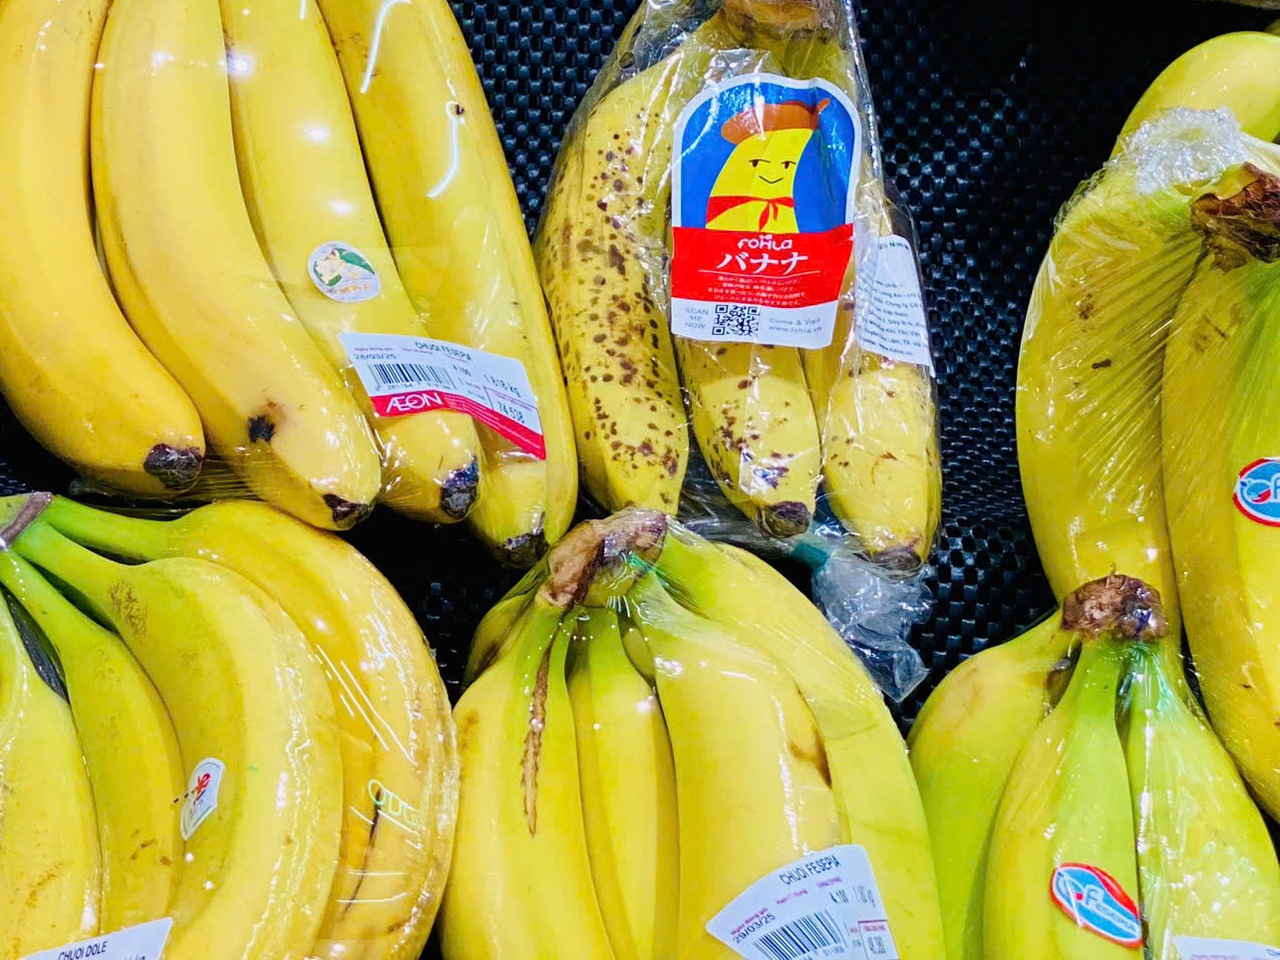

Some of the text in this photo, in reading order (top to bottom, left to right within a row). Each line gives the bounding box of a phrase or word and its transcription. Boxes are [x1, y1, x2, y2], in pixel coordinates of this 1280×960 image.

[715, 251, 809, 276] バナナ
[685, 307, 709, 315] SCAN
[685, 321, 706, 329] NOW
[354, 353, 397, 361] 28/03/25
[779, 865, 810, 885] CHUOI
[732, 913, 776, 945] 29/03/25
[85, 940, 108, 957] DOLE
